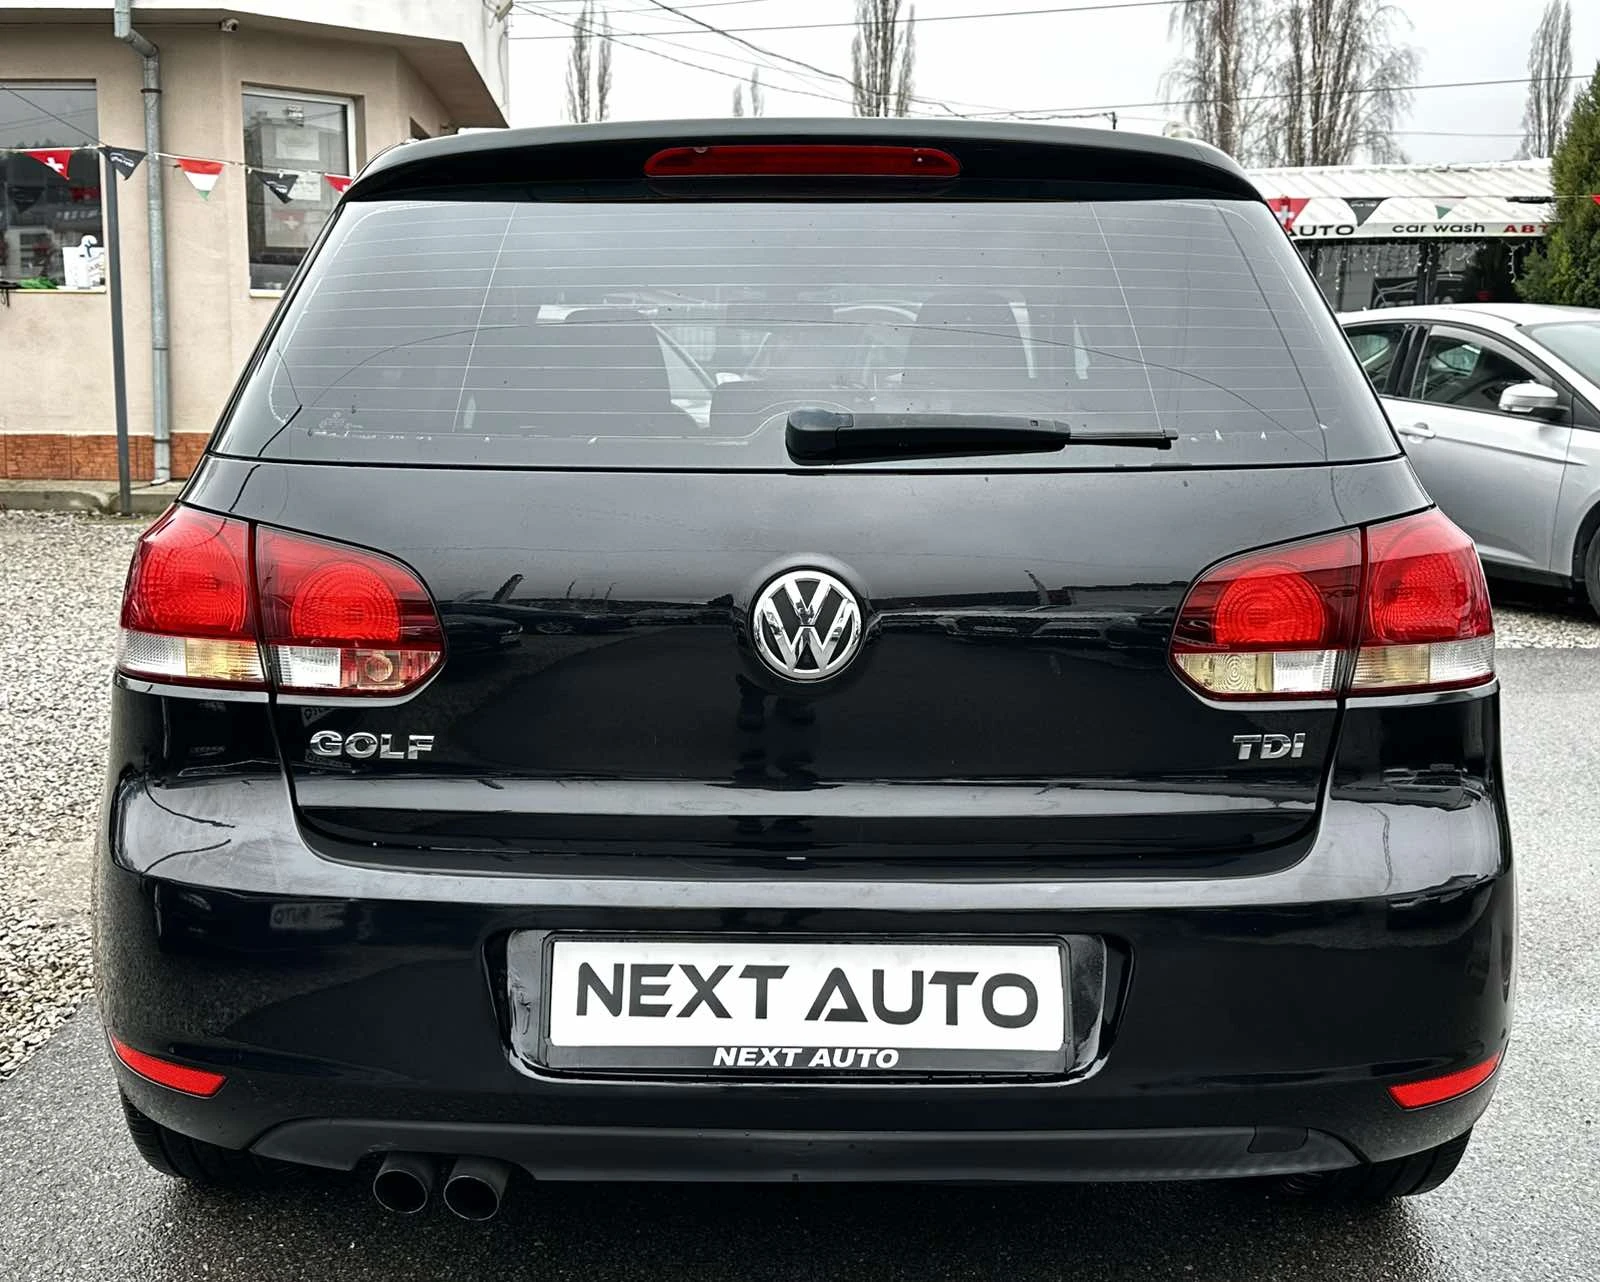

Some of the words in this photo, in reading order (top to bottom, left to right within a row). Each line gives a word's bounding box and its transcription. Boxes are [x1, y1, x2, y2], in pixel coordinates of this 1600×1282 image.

[1392, 224, 1427, 233] car
[1433, 222, 1485, 233] wash
[310, 730, 435, 760] GOLF
[1232, 732, 1306, 760] TDI
[575, 961, 790, 1020] NEXT
[804, 966, 1040, 1029] AUTO
[712, 1047, 803, 1067] NEXT
[808, 1048, 900, 1069] AUTO
